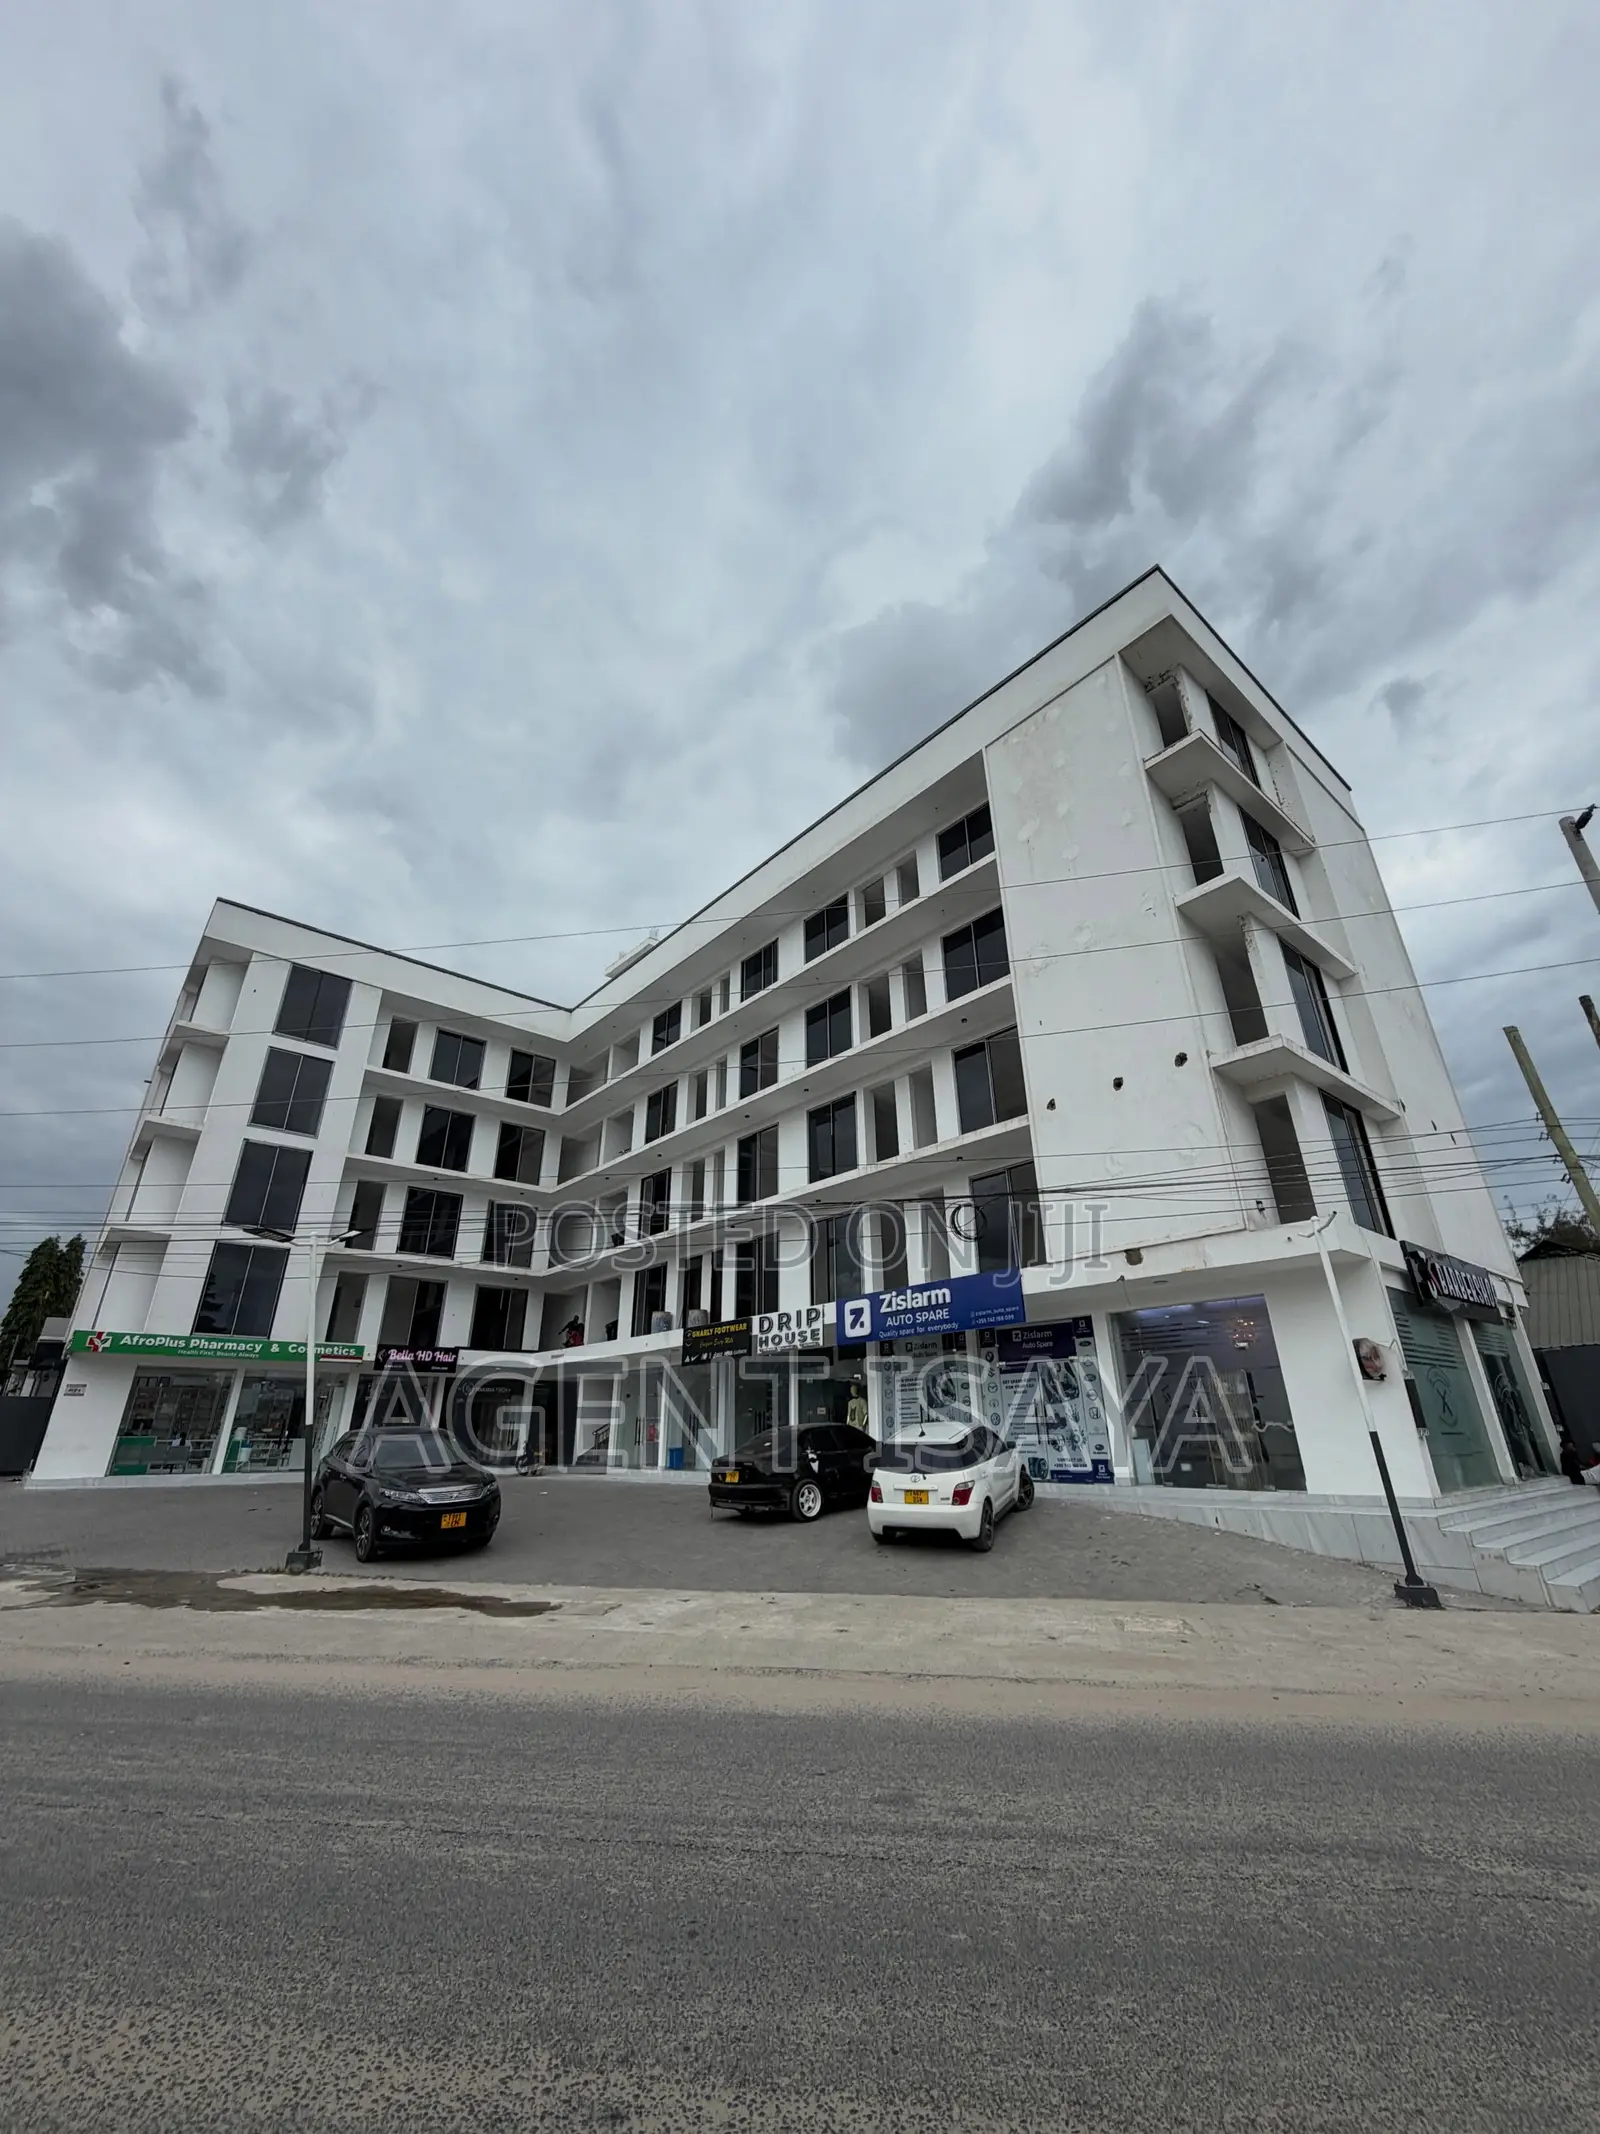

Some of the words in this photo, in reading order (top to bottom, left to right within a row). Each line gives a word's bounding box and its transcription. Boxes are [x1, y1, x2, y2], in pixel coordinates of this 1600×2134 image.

[879, 1287, 952, 1313] Zislarm
[758, 1307, 821, 1335] DRIP
[886, 1314, 913, 1327] AUTO
[915, 1308, 950, 1323] SPARE
[692, 1327, 714, 1338] GNARLY
[714, 1322, 748, 1335] FOOTWEAR
[758, 1328, 821, 1348] HOUSE
[879, 1326, 899, 1339] Quality
[899, 1326, 915, 1337] spare
[916, 1325, 926, 1334] for
[927, 1321, 959, 1333] everybody
[1022, 1330, 1053, 1340] Zislarm
[120, 1335, 185, 1348] AfroPlus
[189, 1338, 263, 1353] Pharmacy
[270, 1343, 280, 1353] &
[288, 1344, 356, 1356] Cometics
[1022, 1341, 1036, 1349] Auto
[1036, 1340, 1054, 1348] Spare
[388, 1348, 414, 1361] Bella
[415, 1351, 433, 1361] HD
[433, 1351, 456, 1362] Hair
